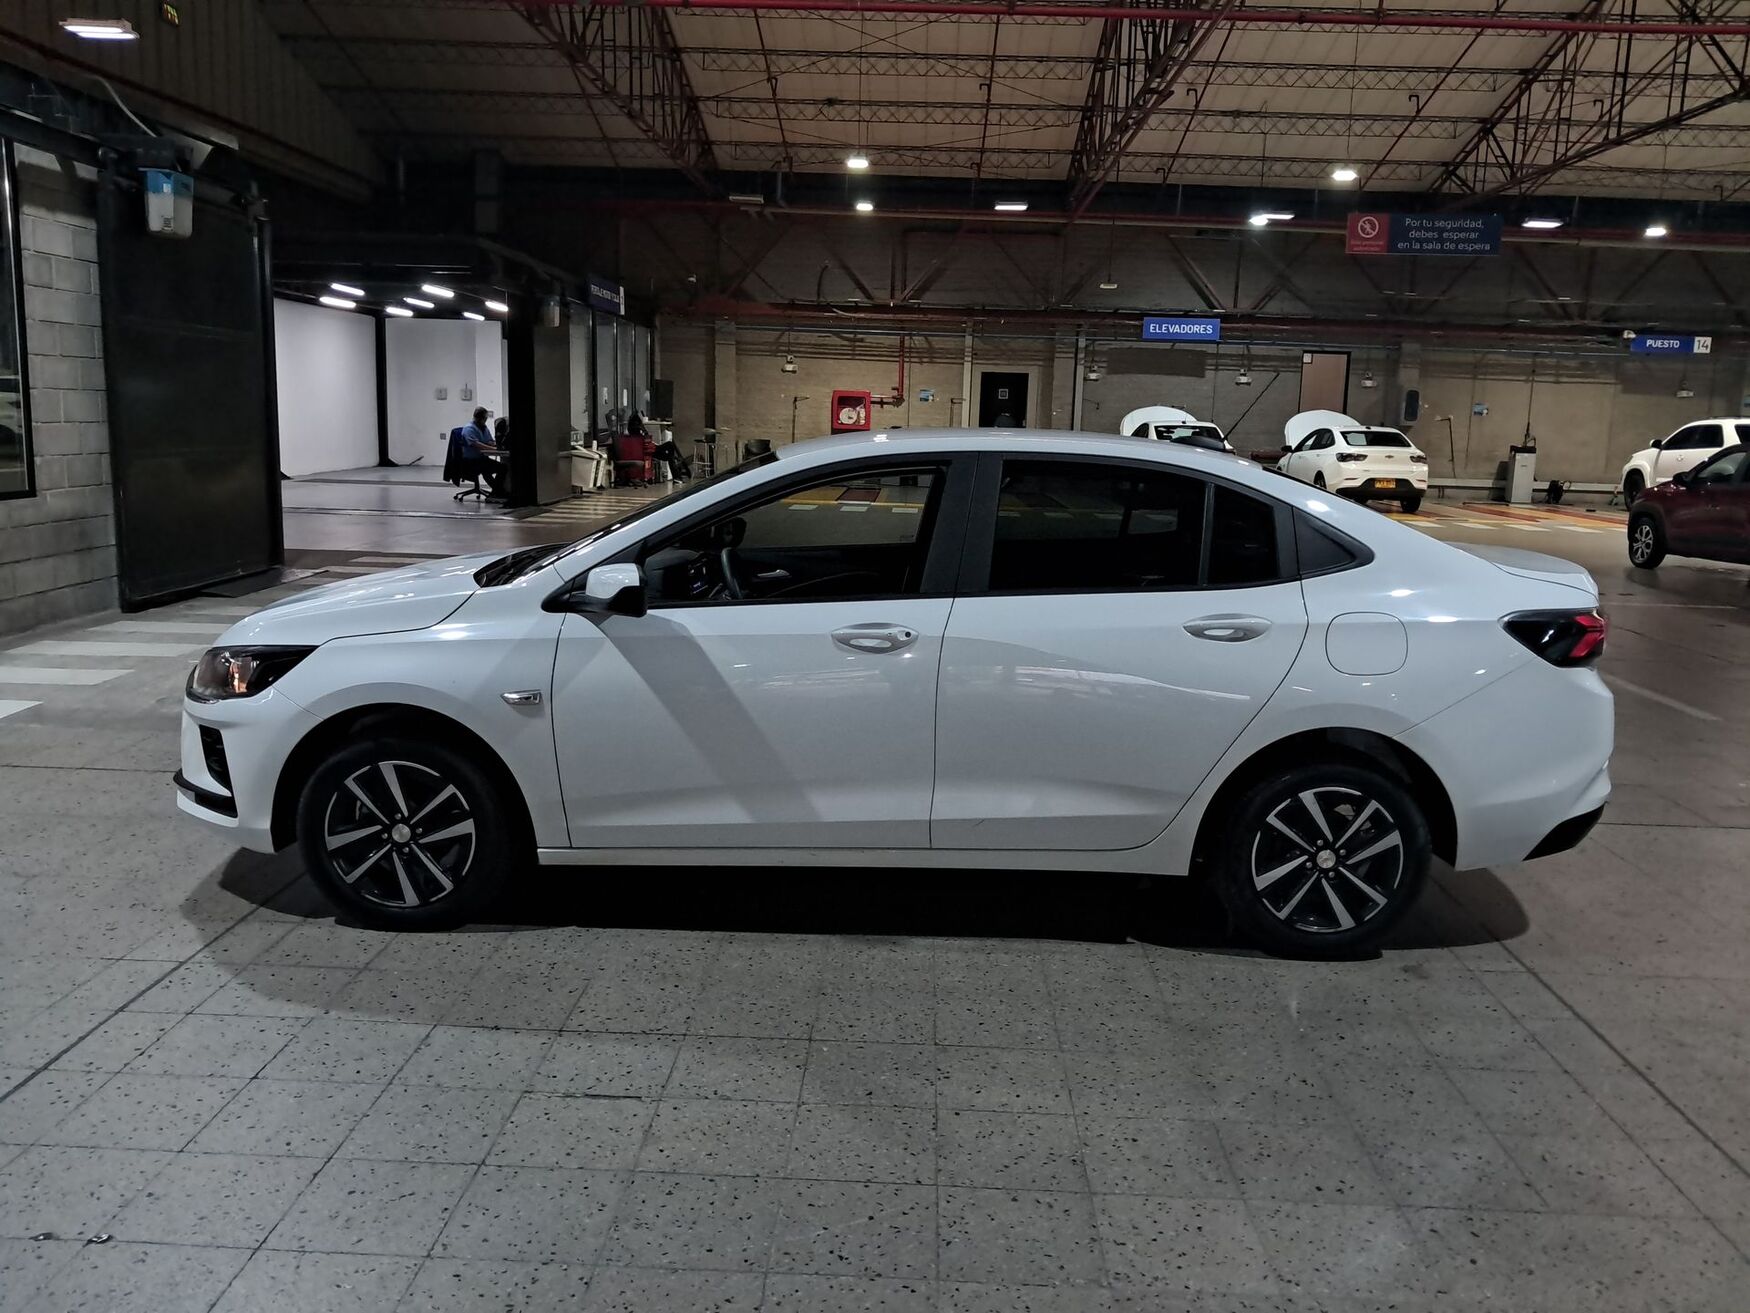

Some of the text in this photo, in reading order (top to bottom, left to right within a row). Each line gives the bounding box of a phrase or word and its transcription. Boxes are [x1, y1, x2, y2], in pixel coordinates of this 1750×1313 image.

[1405, 218, 1484, 230] Por tu seguridad,
[1409, 229, 1479, 241] debes esperar
[1397, 240, 1491, 252] en la sala de espera
[1150, 324, 1213, 334] ELEVADORES
[1646, 340, 1709, 351] PUESTO 14
